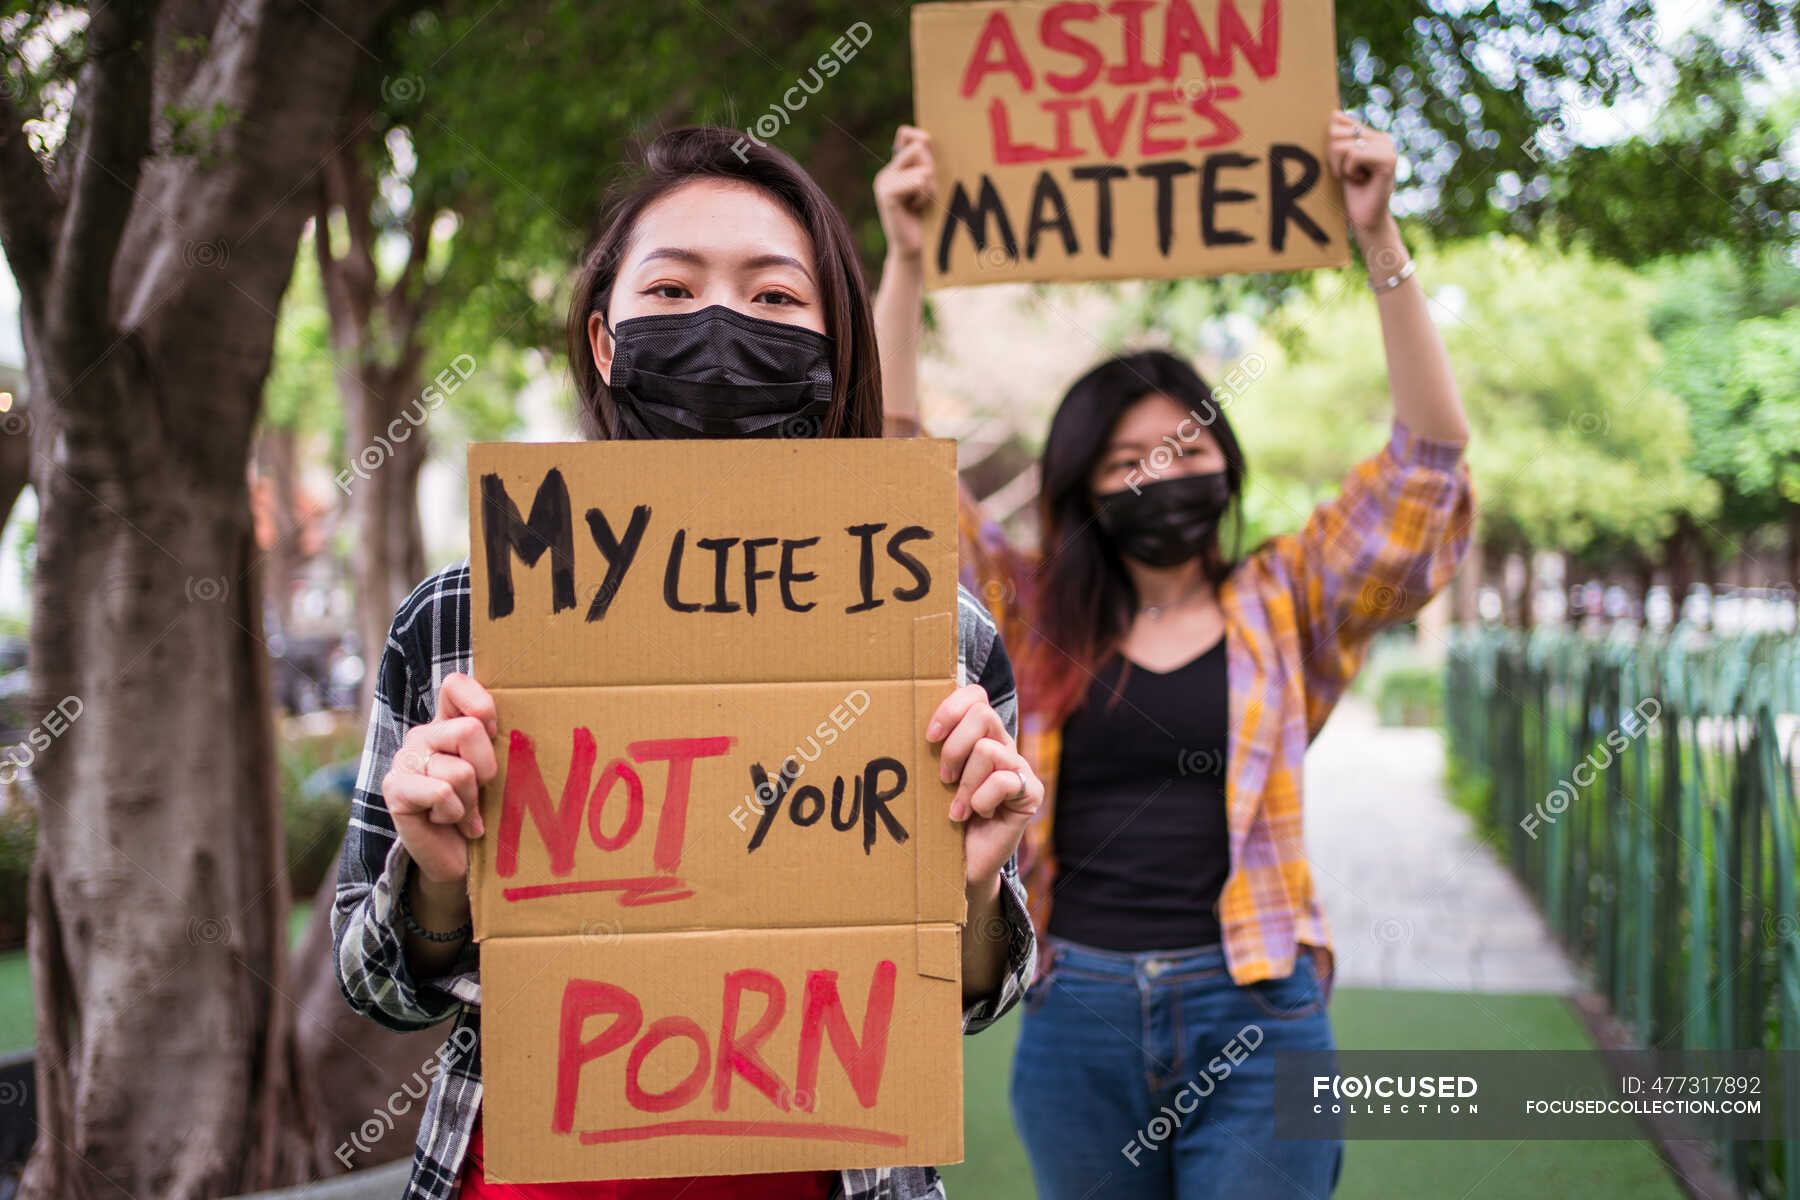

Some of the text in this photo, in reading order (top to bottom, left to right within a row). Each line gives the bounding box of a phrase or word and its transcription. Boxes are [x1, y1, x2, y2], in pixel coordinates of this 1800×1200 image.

[959, 0, 1281, 98] ASIAN
[989, 85, 1242, 165] LIVES
[938, 143, 1331, 274] MATTER
[663, 528, 821, 616] LIFE
[843, 522, 934, 614] IS
[495, 726, 738, 878] NOT
[551, 959, 897, 1136] PORN
